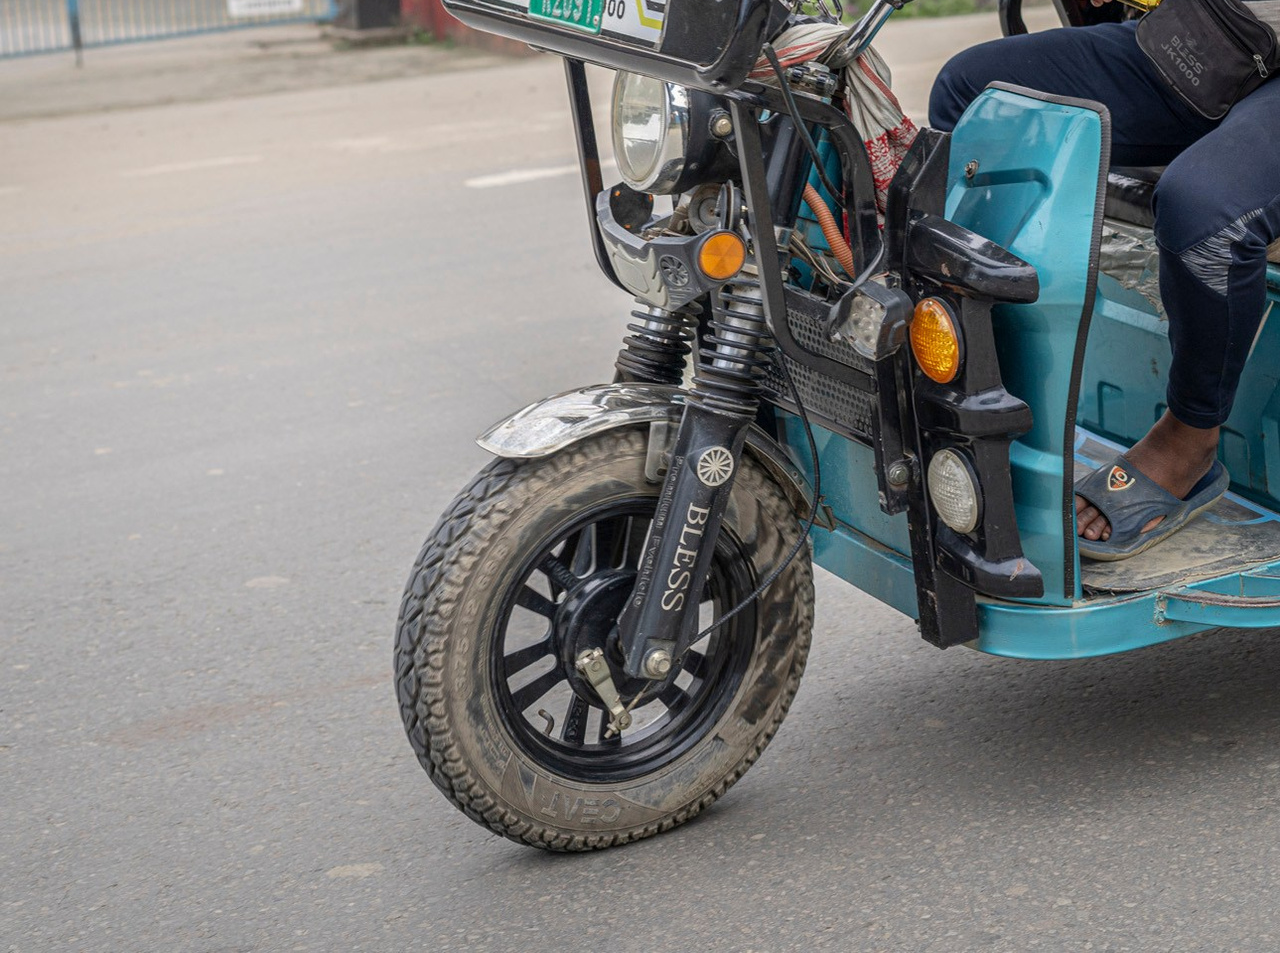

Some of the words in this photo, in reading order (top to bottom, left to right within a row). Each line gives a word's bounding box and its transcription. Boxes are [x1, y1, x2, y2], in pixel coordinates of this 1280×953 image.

[1161, 43, 1200, 86] JK1000
[1171, 35, 1204, 74] BLESS
[661, 502, 711, 612] BLESS
[540, 790, 621, 825] CEAT
